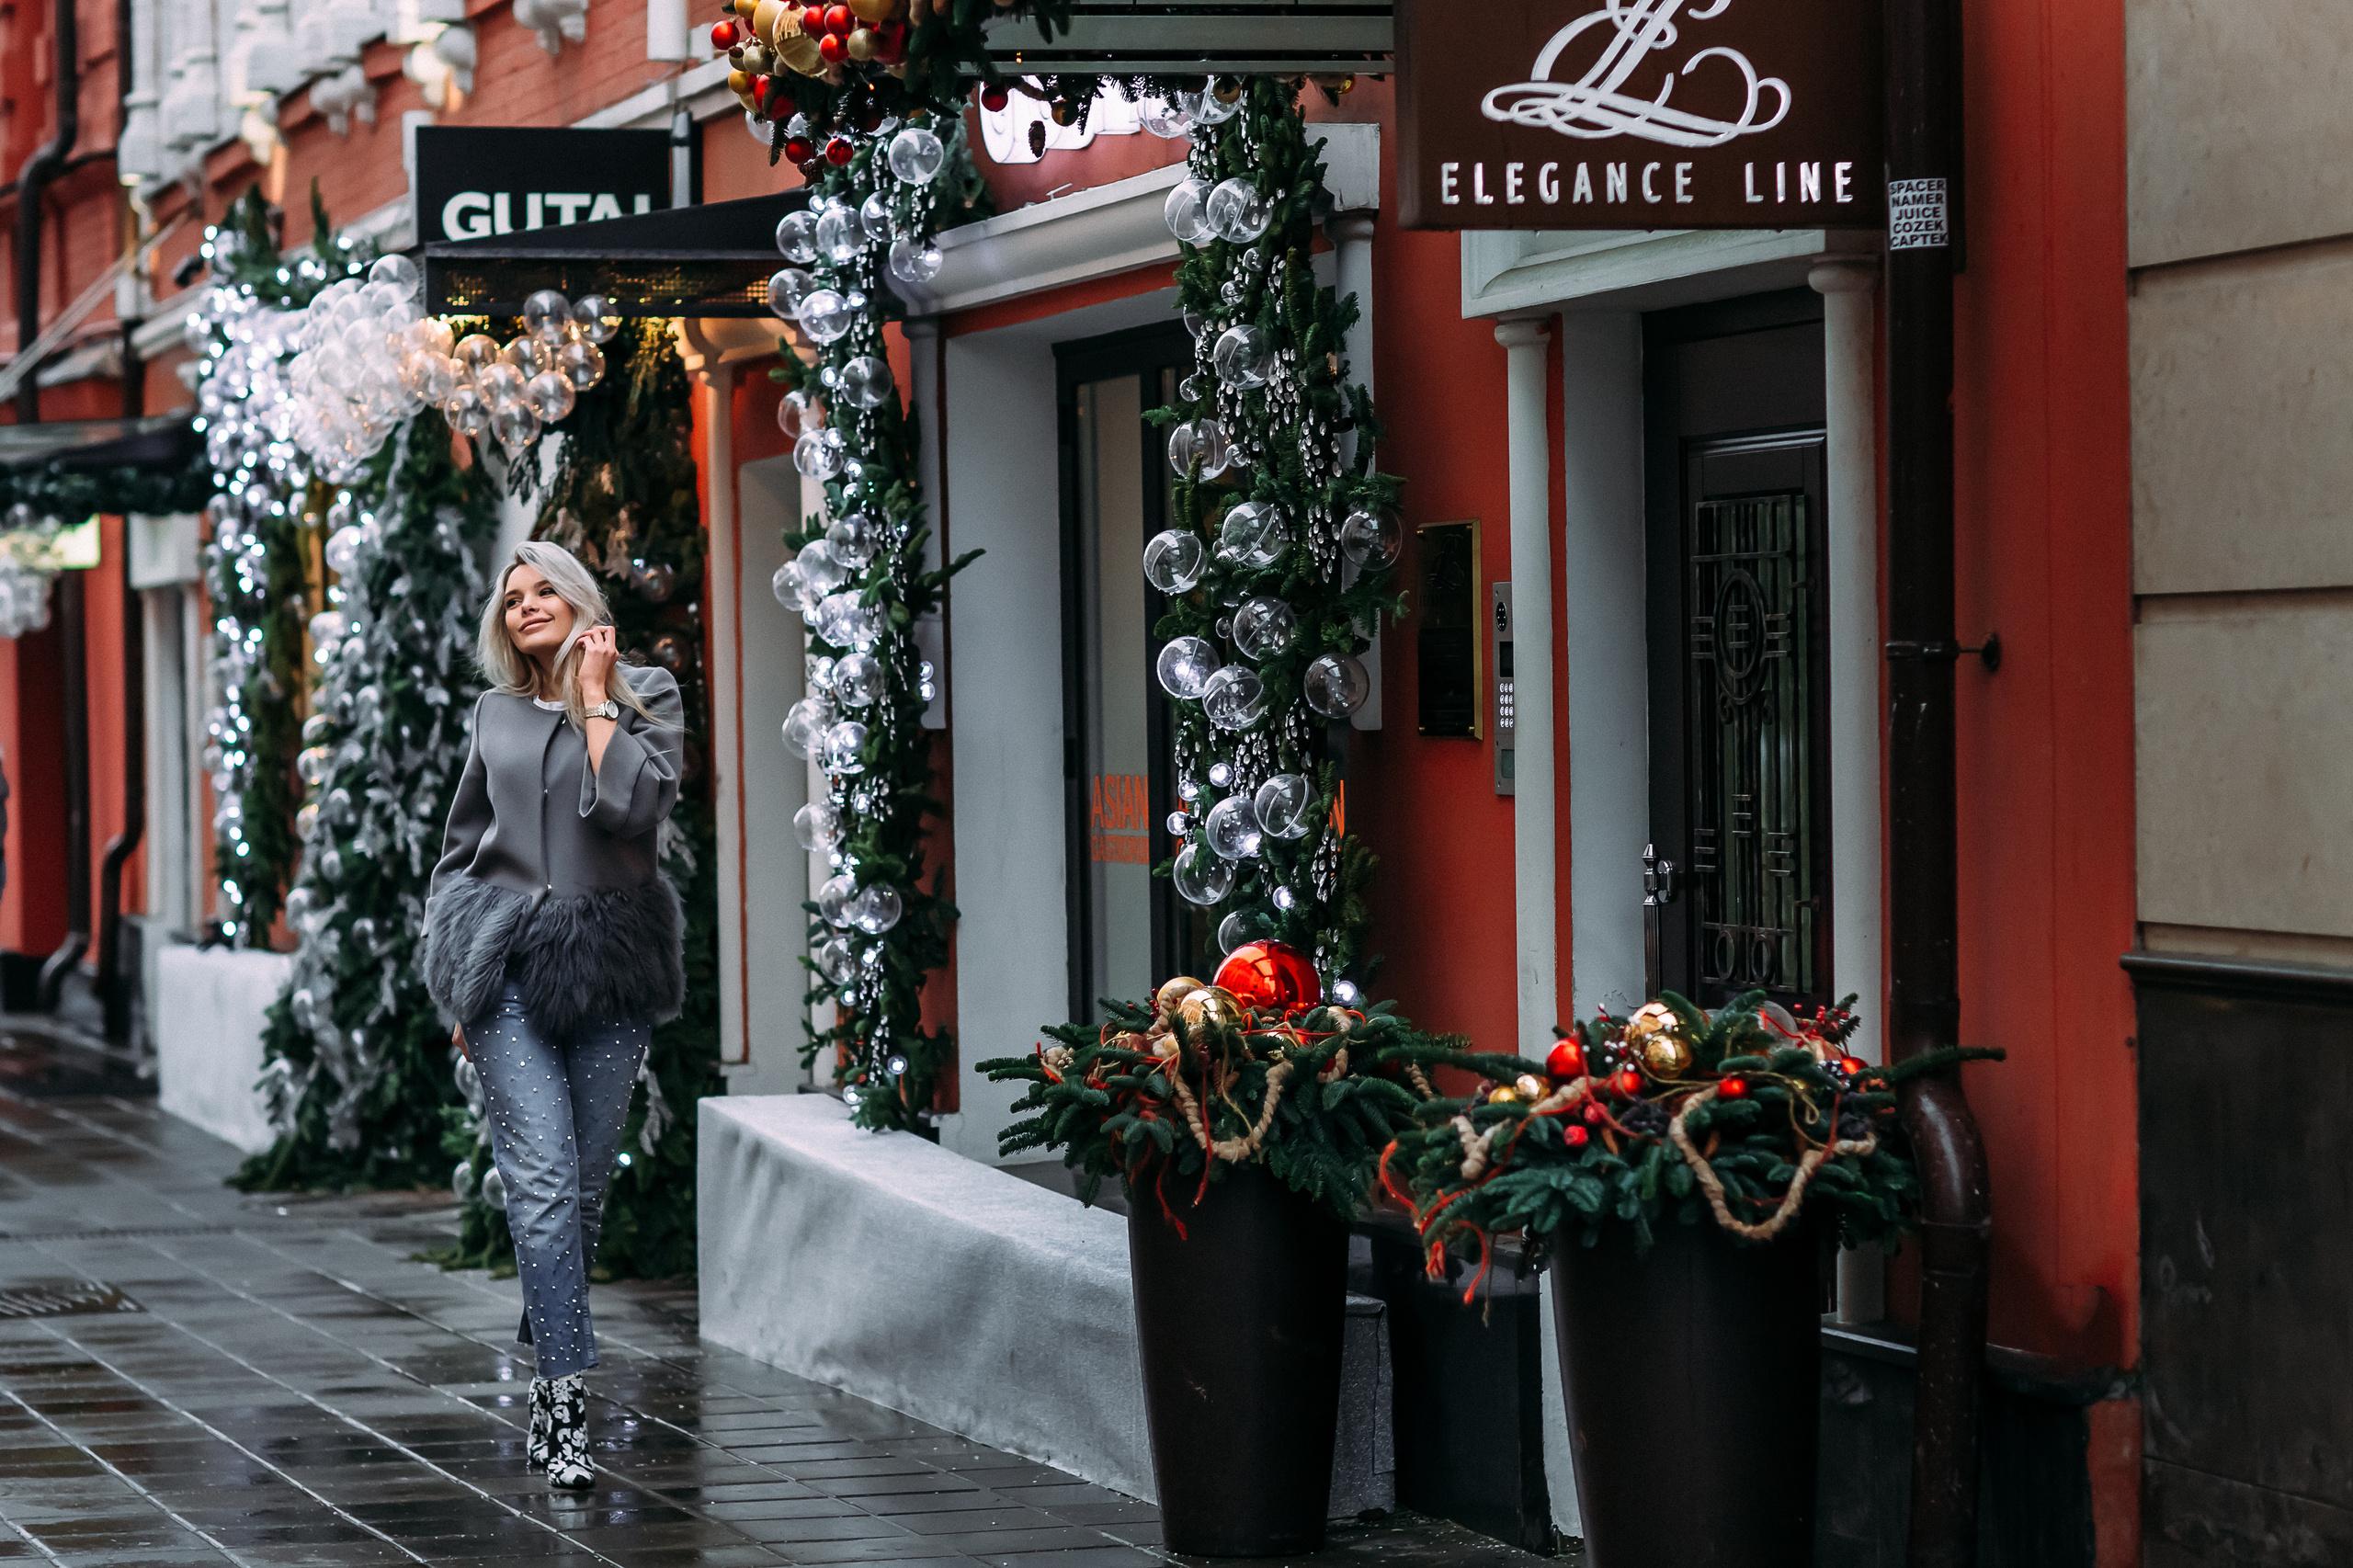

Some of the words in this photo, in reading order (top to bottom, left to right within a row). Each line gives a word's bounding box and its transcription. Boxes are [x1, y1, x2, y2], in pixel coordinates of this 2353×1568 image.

[1440, 162, 1694, 205] ELEGANCE
[1745, 161, 1854, 204] LINE
[1889, 180, 1945, 195] SPACER
[1892, 193, 1944, 208] NAMER
[1895, 207, 1941, 221] JUICE
[1893, 220, 1944, 234] COZEK
[1091, 775, 1149, 829] ASIAN
